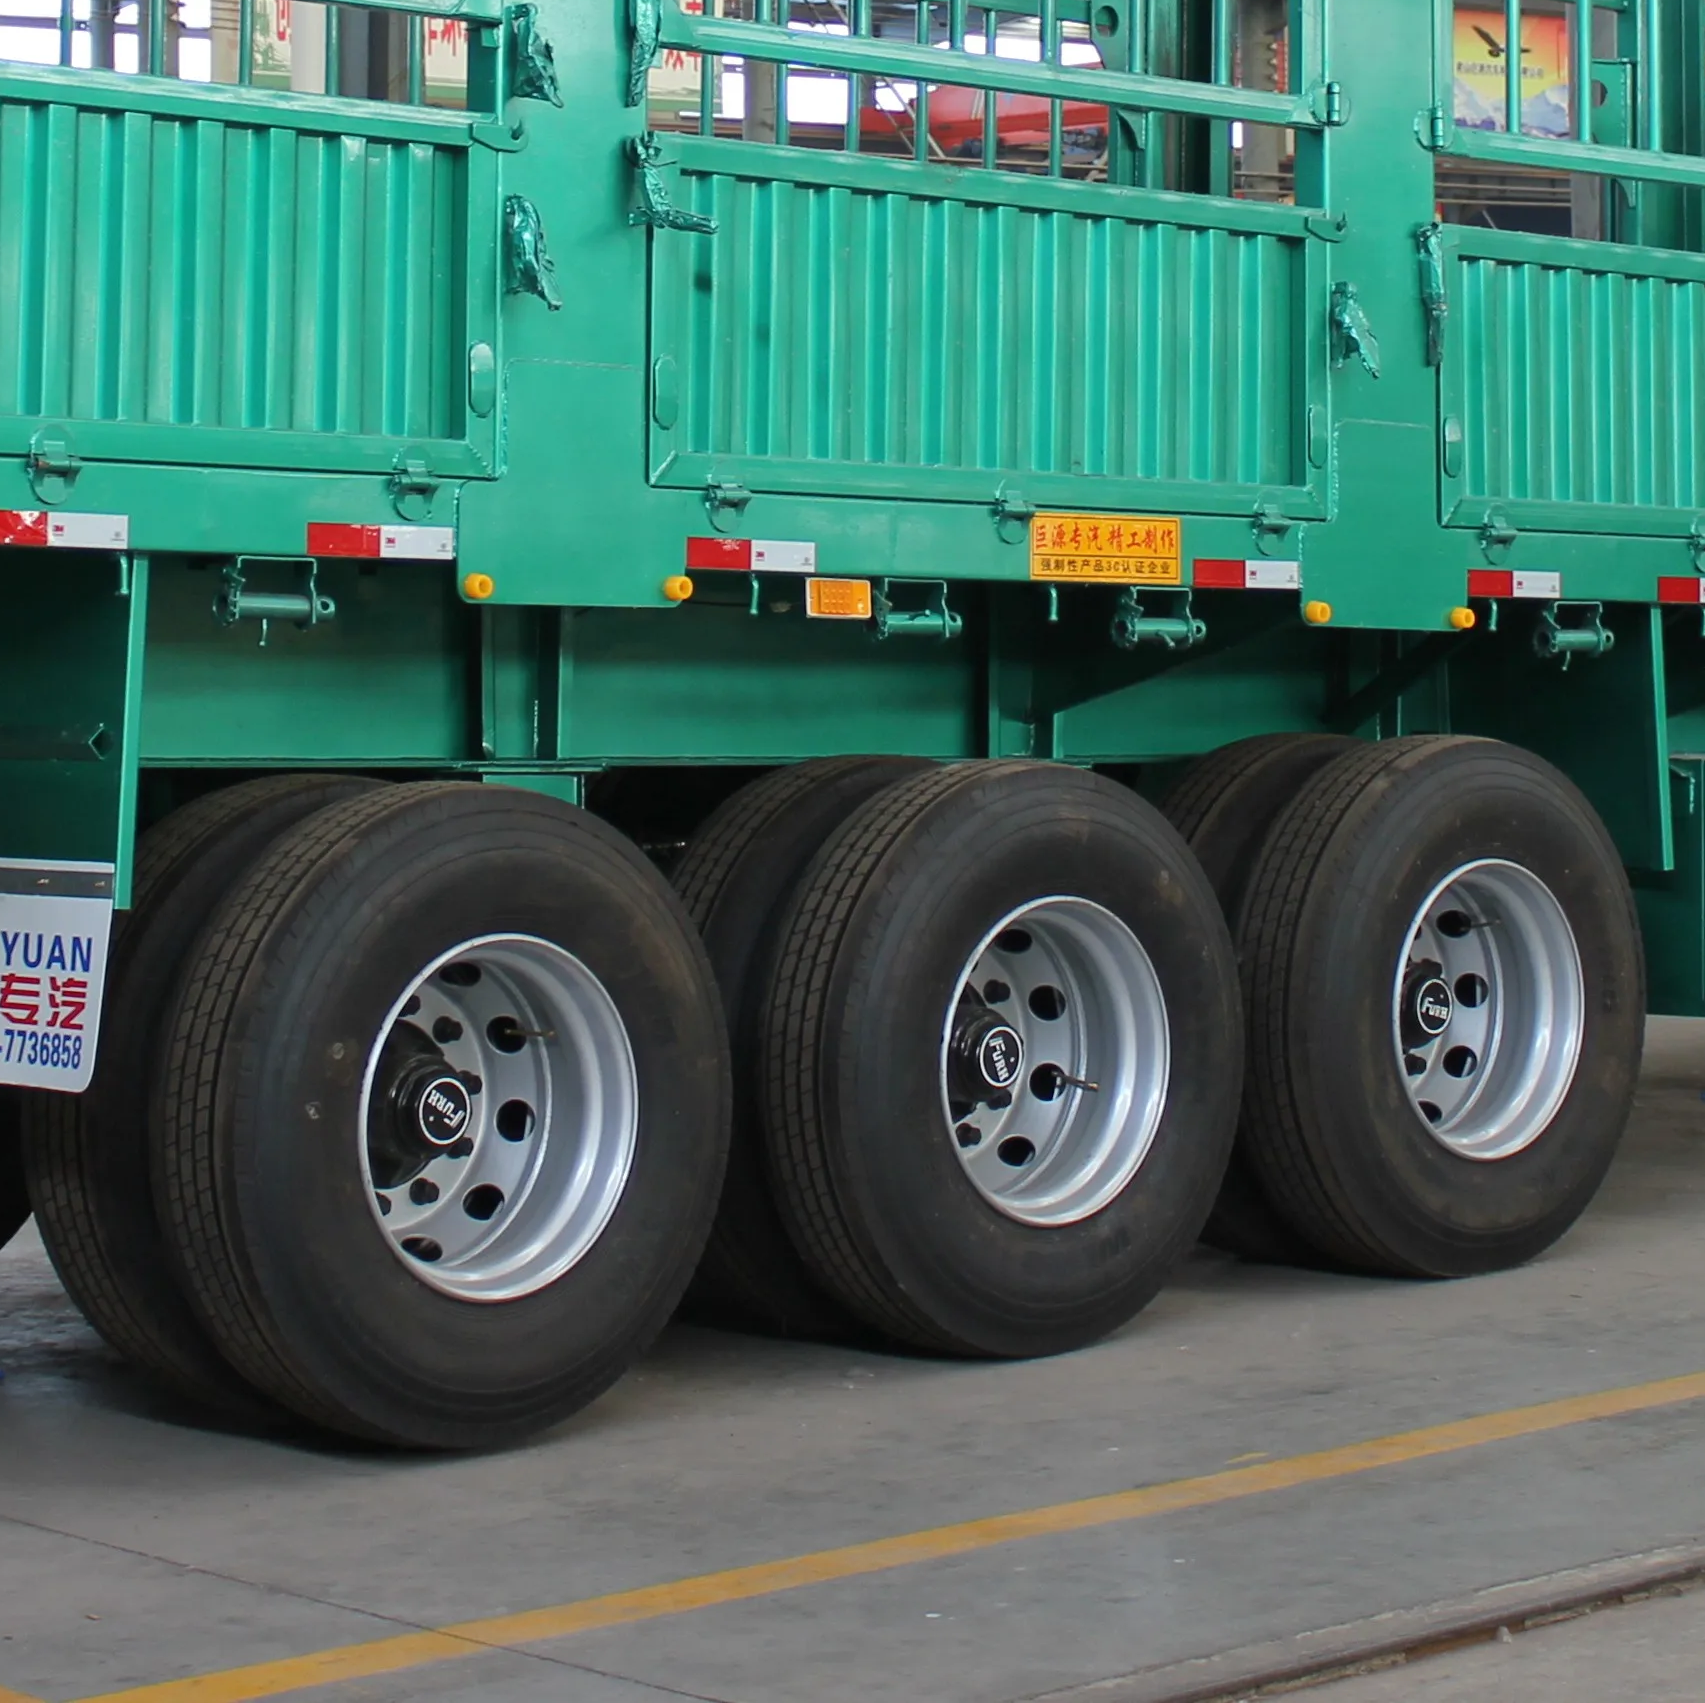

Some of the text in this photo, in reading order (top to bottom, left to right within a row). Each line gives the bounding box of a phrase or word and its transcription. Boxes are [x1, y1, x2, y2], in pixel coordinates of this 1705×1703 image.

[1040, 557, 1172, 575] 强制性产品3C认证企业
